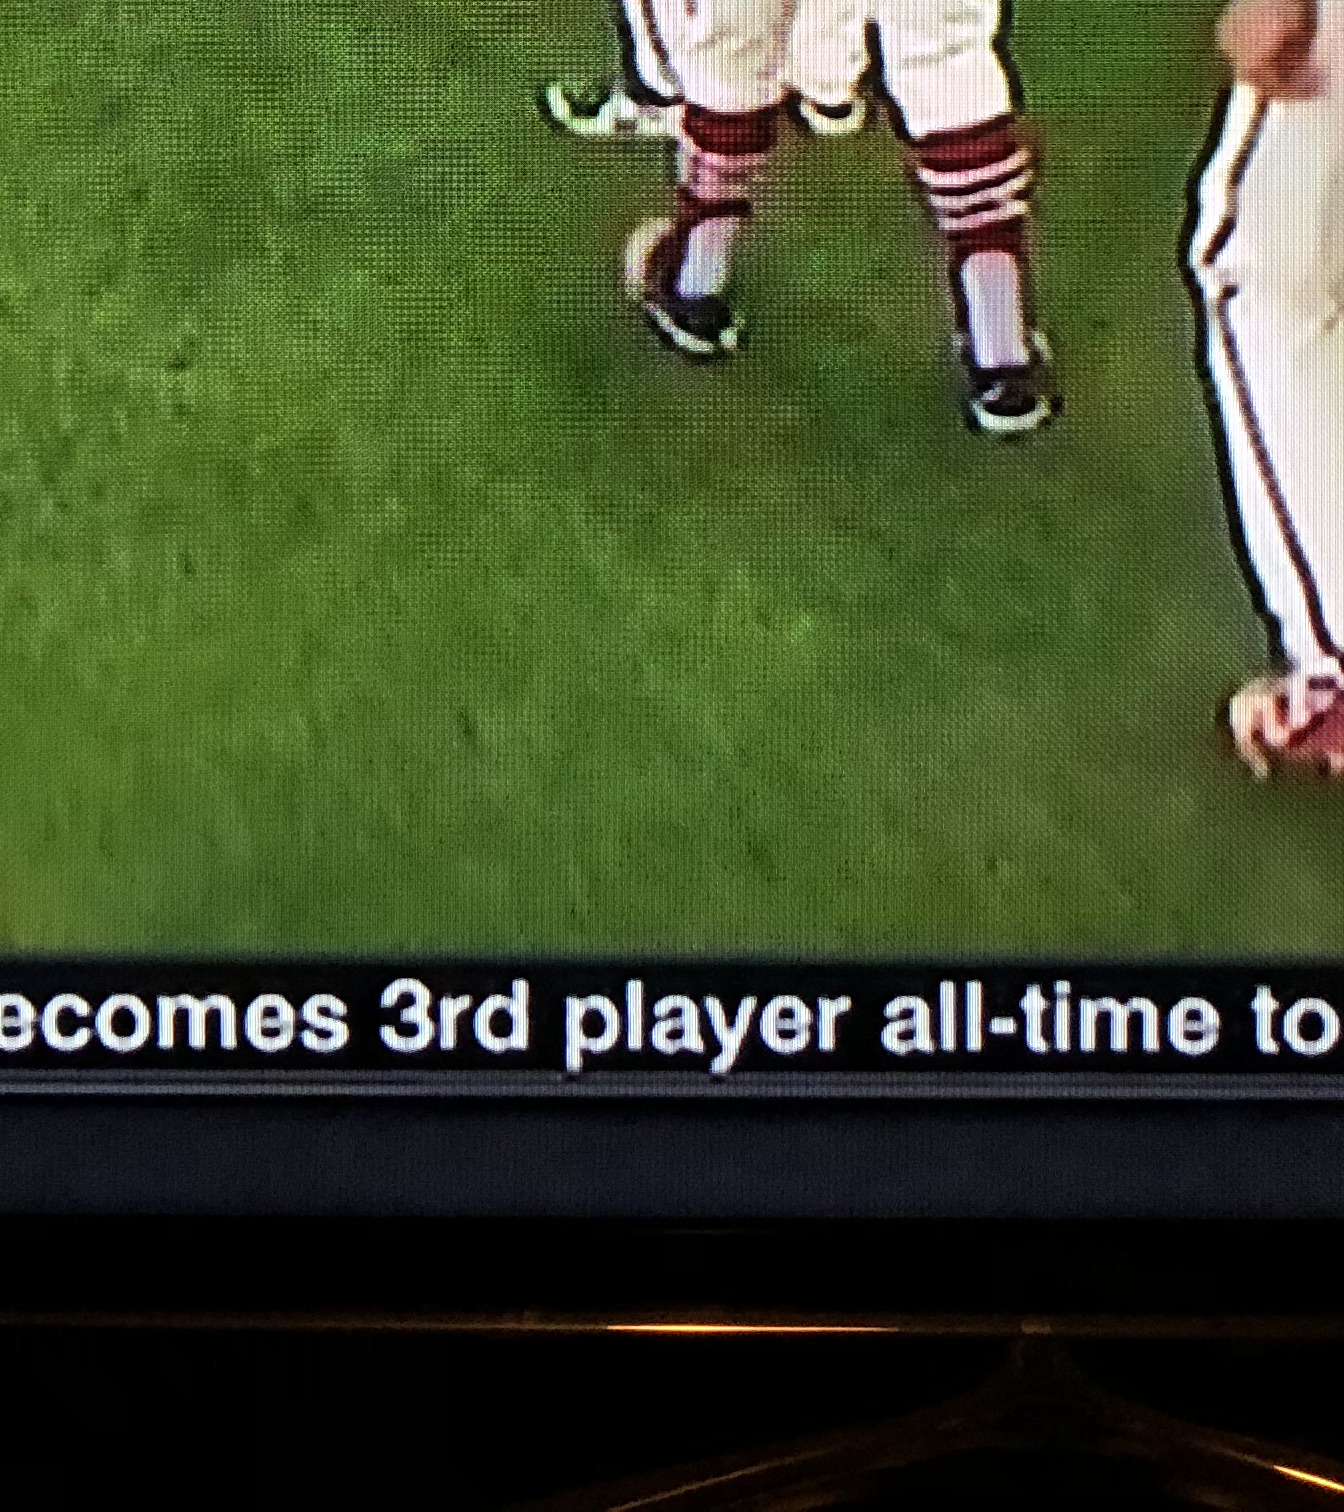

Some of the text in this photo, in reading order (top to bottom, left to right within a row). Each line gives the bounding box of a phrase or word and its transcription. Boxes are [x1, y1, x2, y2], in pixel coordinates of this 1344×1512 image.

[379, 977, 530, 1054] 3rd
[565, 978, 852, 1076] player
[880, 979, 1220, 1055] all-time
[1253, 983, 1341, 1055] to
